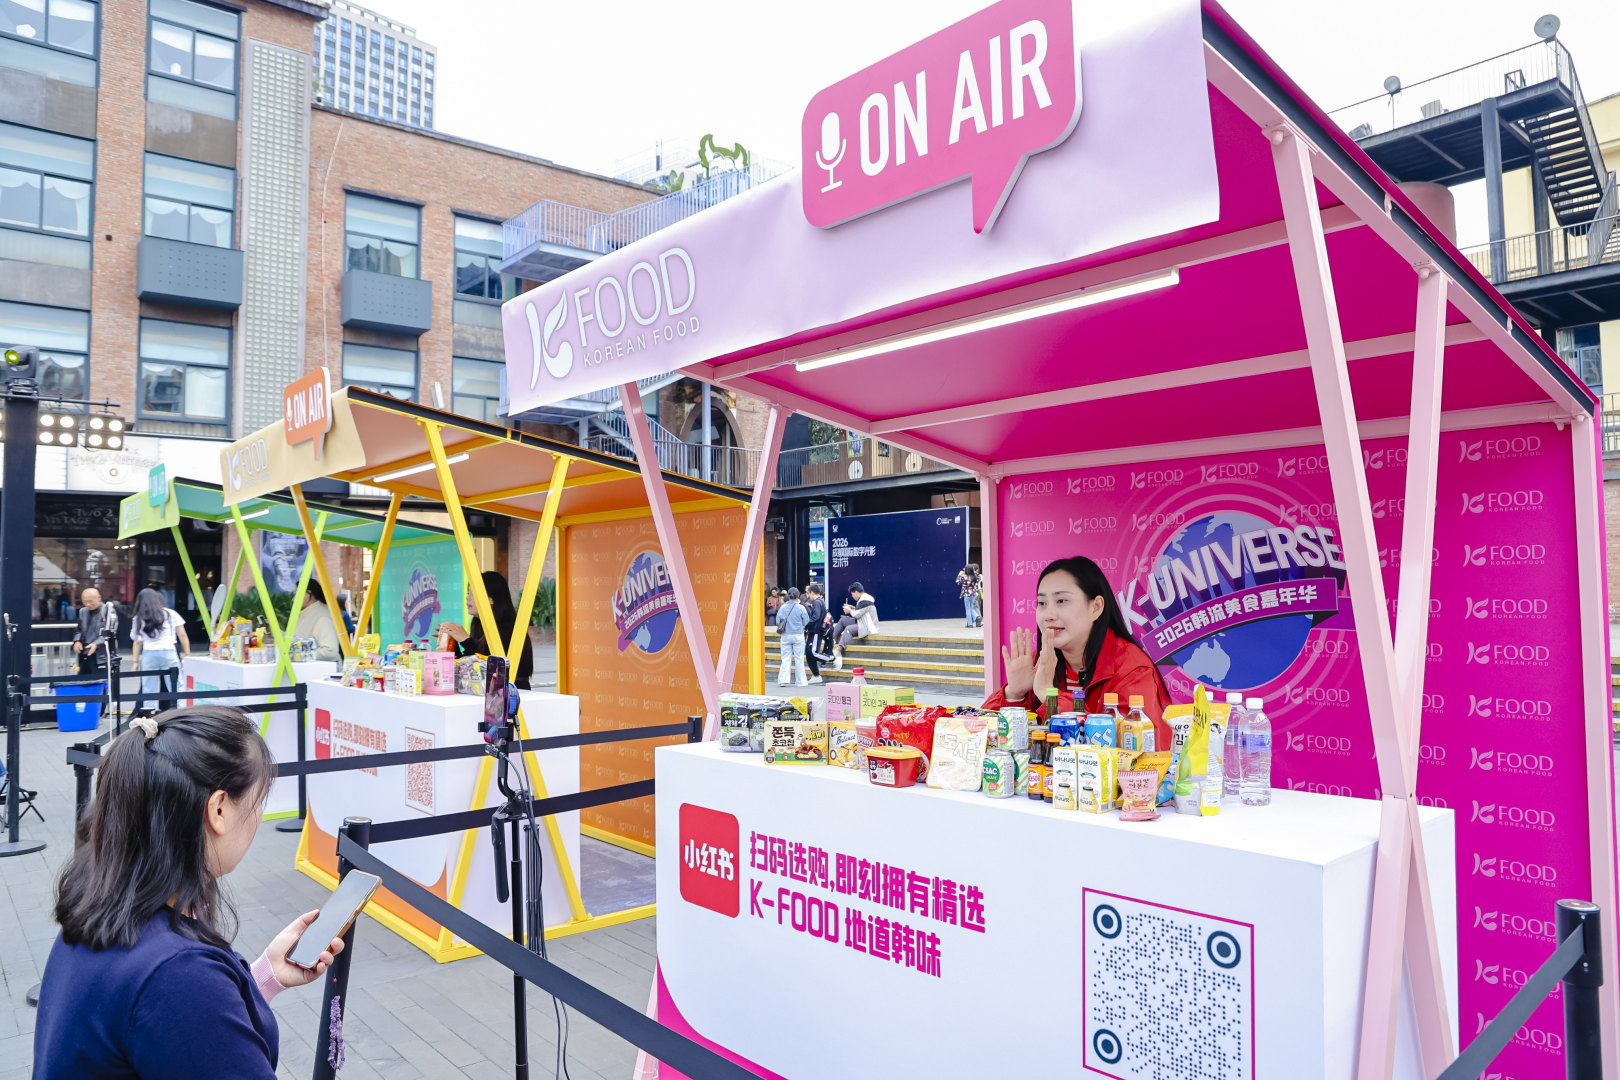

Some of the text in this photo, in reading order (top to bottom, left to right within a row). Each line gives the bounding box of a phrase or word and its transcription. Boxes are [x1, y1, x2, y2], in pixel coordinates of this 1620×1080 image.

[859, 19, 1052, 177] ON AIR
[582, 316, 701, 368] KOREAN FOOD
[294, 382, 325, 429] ON AIR
[1486, 436, 1541, 455] FOOD
[1298, 455, 1328, 471] FOO
[1387, 448, 1408, 463] FO
[1148, 469, 1184, 484] FOOD
[1219, 462, 1259, 478] FOOD
[1023, 481, 1053, 494] FOOD
[1083, 475, 1115, 489] FOOD
[1488, 490, 1543, 507] FOOD
[1025, 520, 1055, 533] FOOD
[1084, 516, 1117, 530] FOOD
[1149, 512, 1185, 526] FOOD
[832, 538, 848, 547] 2026
[1490, 544, 1546, 560] FOOD
[832, 558, 849, 567] 艺术节
[1026, 560, 1050, 570] FOO
[1117, 524, 1346, 636] K-UNIVERSE
[1492, 598, 1548, 614] FOOD
[1155, 585, 1317, 649] 2026韩流美食嘉年华
[1494, 645, 1550, 661] FOOD
[1306, 687, 1350, 702] FOOD
[1495, 698, 1552, 716] FOOD
[772, 726, 795, 738] 쫀득
[1307, 735, 1351, 751] FOOD
[1497, 752, 1554, 771] FOOD
[1497, 767, 1553, 777] KOREAN FOOD
[1498, 806, 1556, 827] FOOD
[1499, 820, 1530, 829] KOREAN
[683, 839, 734, 881] 小红书
[1500, 859, 1557, 882] FOOD
[1500, 874, 1556, 888] KOREAN FOOD
[750, 879, 942, 978] K-FOOD 地道韩味
[1509, 1037, 1537, 1048] OREAN
[1512, 1025, 1562, 1049] OOD
